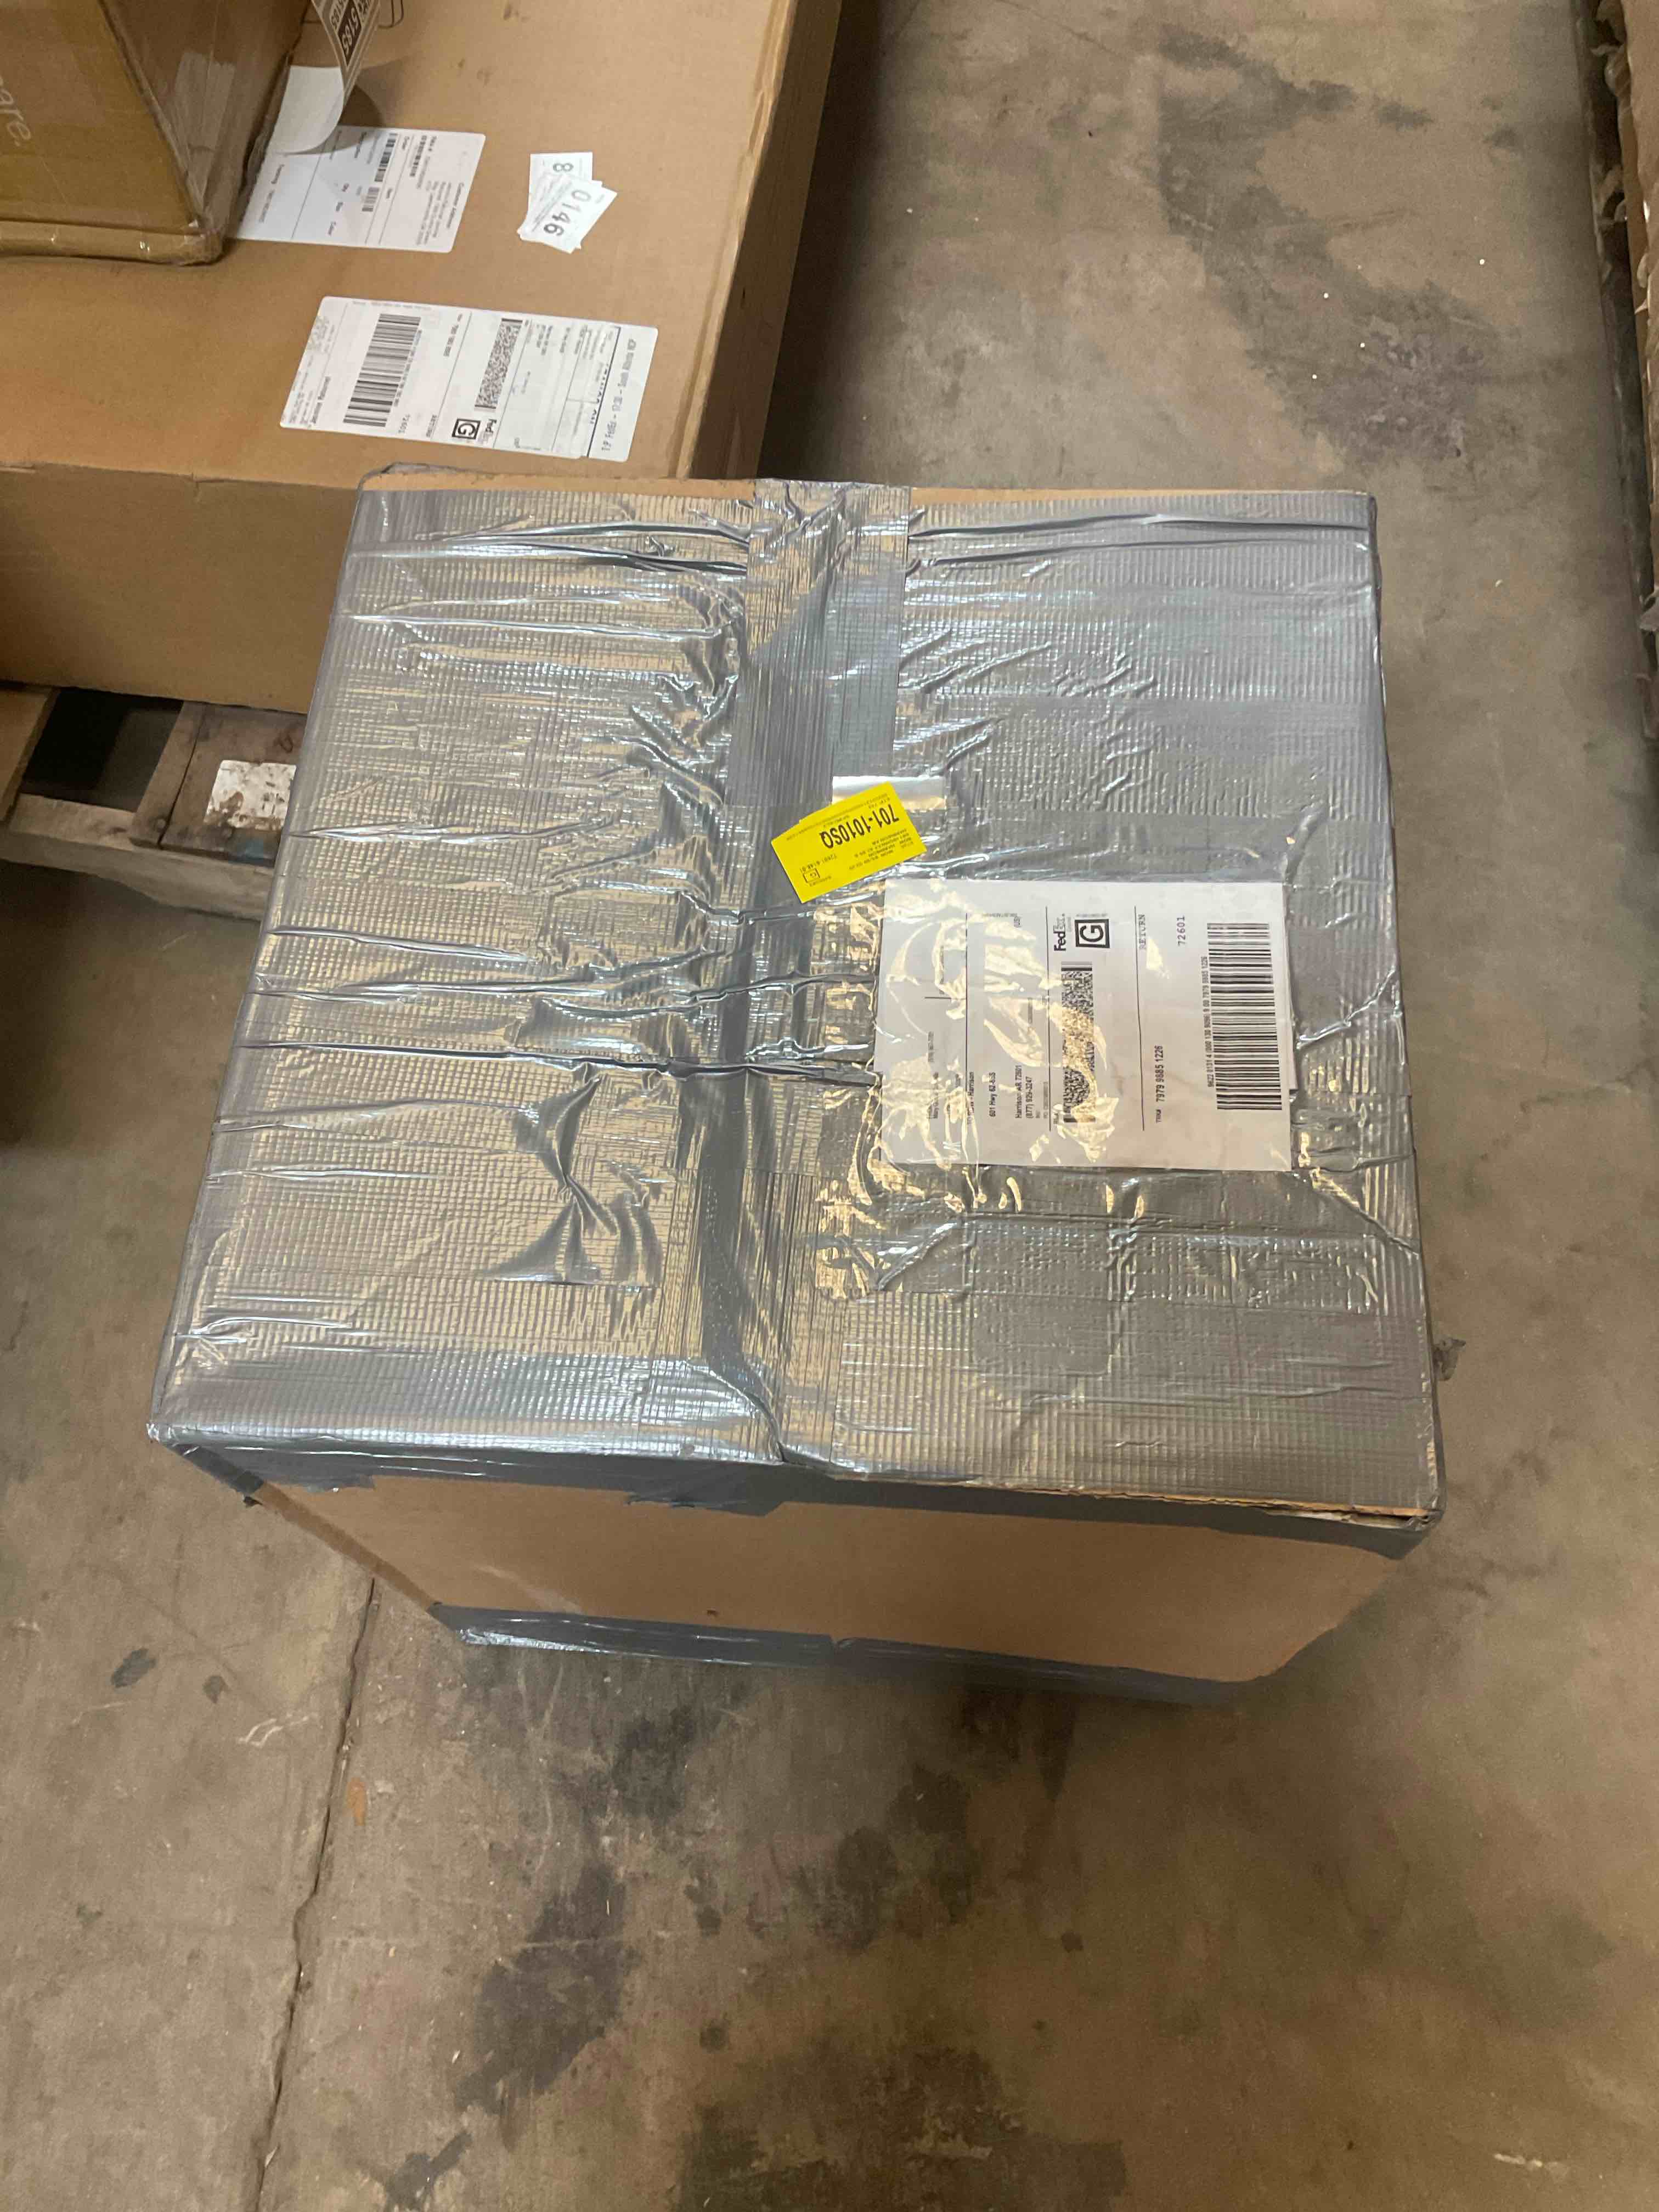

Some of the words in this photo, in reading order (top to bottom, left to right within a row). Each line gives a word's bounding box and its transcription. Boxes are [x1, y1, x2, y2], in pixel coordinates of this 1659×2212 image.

[0, 74, 31, 147] are.
[543, 189, 592, 236] 0146
[819, 804, 900, 849] 701-1010SQ
[1079, 924, 1104, 943] G
[1176, 915, 1186, 946] 72601
[1154, 1045, 1164, 1064] 1226
[1155, 1064, 1164, 1084] 9885
[1156, 1085, 1165, 1102] 7979
